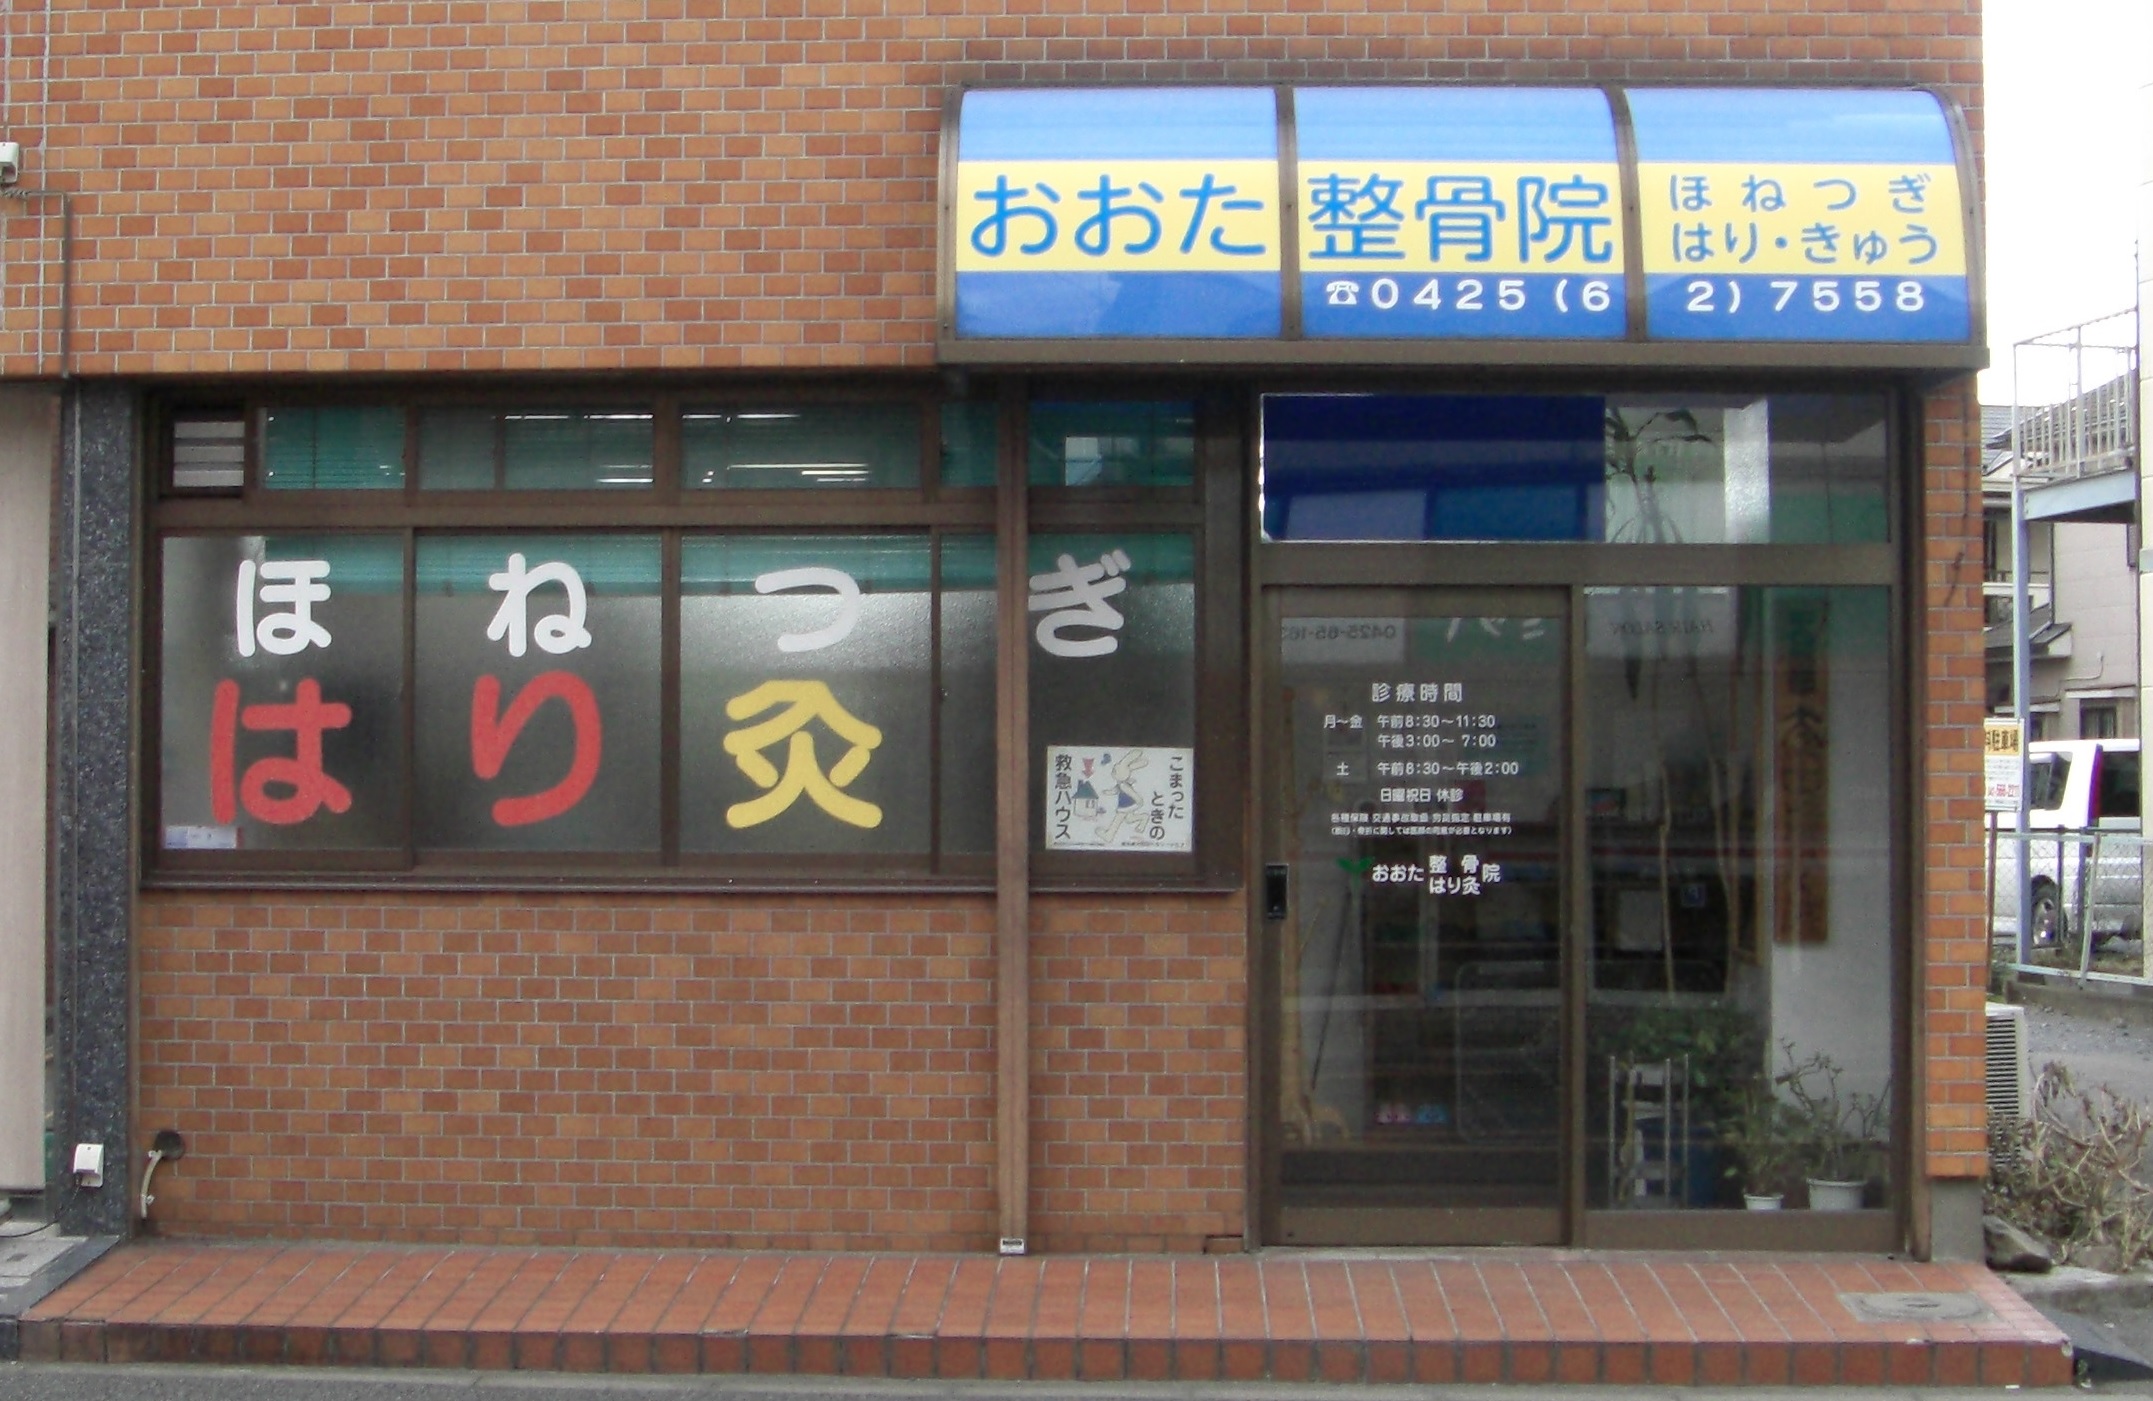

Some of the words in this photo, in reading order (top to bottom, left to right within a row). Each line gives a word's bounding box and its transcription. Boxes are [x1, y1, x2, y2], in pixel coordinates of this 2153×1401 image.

[970, 173, 1266, 258] おおた
[1308, 172, 1614, 264] 整骨院
[1673, 223, 1938, 263] はり・きゅう
[1371, 682, 1463, 703] 診療時間
[1168, 756, 1184, 820] こまった
[1336, 762, 1350, 776] 土
[1054, 753, 1072, 839] 救急ハウス
[1150, 790, 1165, 840] ときの
[1372, 865, 1424, 882] おおた
[1482, 864, 1501, 882] 院
[1429, 876, 1480, 895] はり灸
